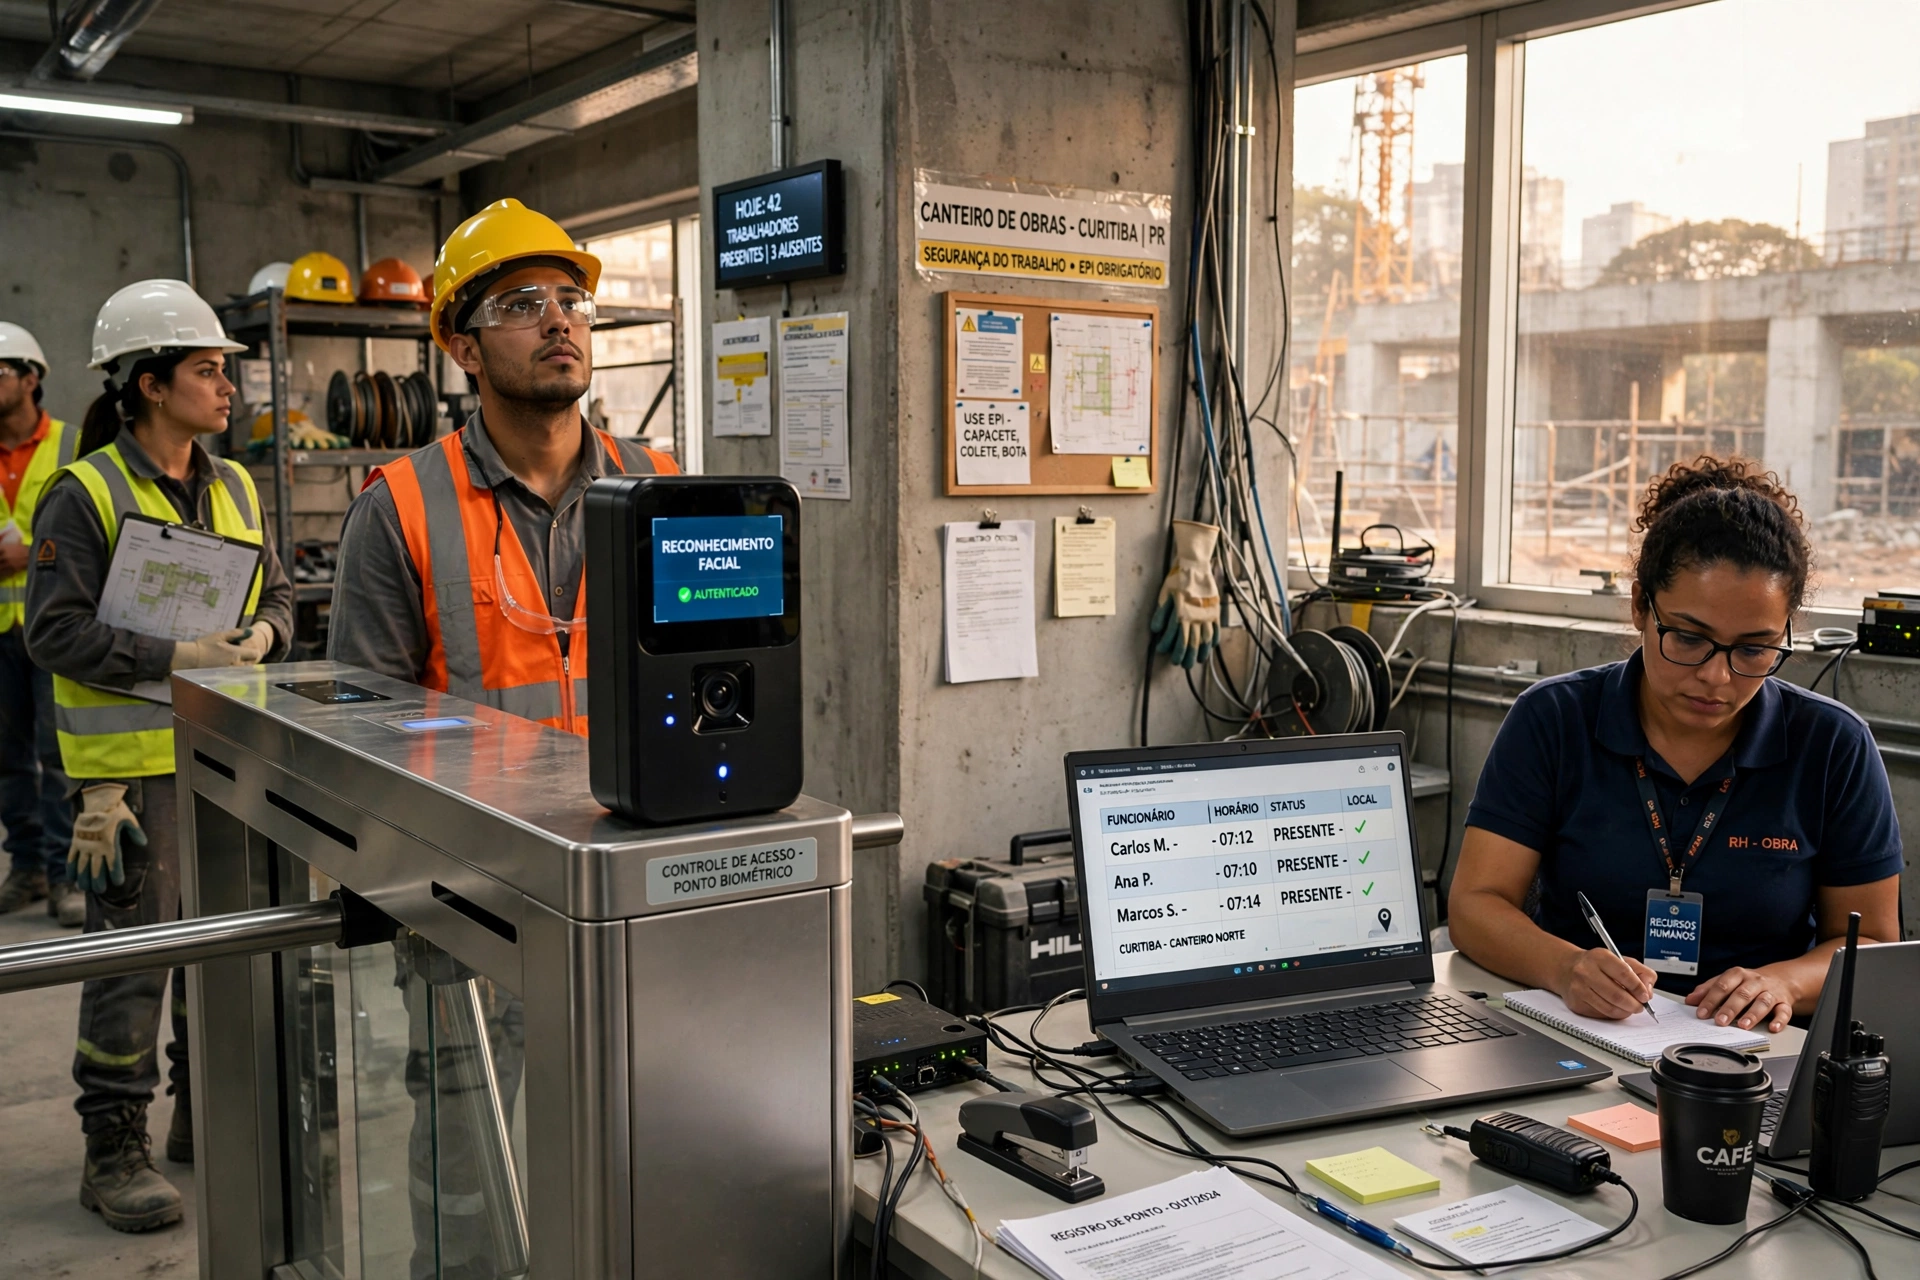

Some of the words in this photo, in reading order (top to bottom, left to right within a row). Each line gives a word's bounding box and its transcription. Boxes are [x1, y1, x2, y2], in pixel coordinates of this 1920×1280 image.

[735, 196, 766, 220] HOJE:
[767, 193, 782, 212] 42
[726, 215, 799, 244] TRABALHADORES
[920, 201, 994, 228] CANTEIRO
[998, 209, 1016, 230] DE
[1020, 211, 1067, 235] OBRAS
[1078, 218, 1138, 243] CURITIBA
[1149, 226, 1166, 246] PR
[720, 246, 764, 268] PRESENTES
[771, 244, 777, 260] 3
[778, 236, 823, 259] AUSENTES
[924, 246, 991, 270] SEGURANÇA
[993, 252, 1009, 267] DO
[1012, 254, 1066, 273] TRABALHO
[1079, 260, 1095, 275] EPI
[1097, 261, 1162, 281] OBRIGATÓRIO
[963, 412, 985, 425] USE
[988, 413, 1005, 425] EPI
[963, 429, 1020, 443] CAPACETE,
[960, 446, 1000, 459] COLETE,
[1002, 446, 1027, 457] BOTA
[661, 537, 774, 554] RECONHECIMENTO
[698, 556, 741, 571] FACIAL
[694, 585, 759, 600] AUTENTICADO
[1107, 807, 1176, 826] FUNCIONÁRIO
[1214, 801, 1259, 817] HORÁRIO
[1270, 799, 1306, 812] STATUS
[1347, 794, 1378, 806] LOCAL
[1110, 839, 1151, 856] Carlos
[1153, 838, 1171, 852] M.
[1219, 830, 1254, 847] 07:12
[1273, 823, 1335, 842] PRESENTE
[1728, 836, 1749, 848] RH
[1761, 837, 1799, 850] OBRA
[662, 857, 728, 878] CONTROLE
[731, 854, 747, 868] DE
[750, 847, 796, 866] ACESSO
[1114, 873, 1140, 890] Ana
[1143, 872, 1154, 887] P.
[1223, 862, 1258, 879] 07:10
[1277, 854, 1339, 873] PRESENTE
[673, 876, 717, 894] PONTO
[720, 865, 793, 887] BIOMÉTRICO
[1117, 905, 1164, 923] Marcos
[1166, 903, 1179, 917] S.
[1226, 894, 1261, 912] 07:14
[1280, 886, 1343, 905] PRESENTE
[1649, 917, 1697, 931] RECURSOS
[1649, 928, 1696, 941] HUMANOS
[1030, 933, 1082, 959] HIL
[1119, 939, 1162, 955] CURITIBA
[1169, 934, 1214, 949] CANTEIRO
[1215, 929, 1246, 943] NORTE
[1696, 1140, 1753, 1166] CAFÉ
[1050, 1222, 1107, 1242] REGISTRO
[1106, 1217, 1125, 1228] DE
[1124, 1206, 1163, 1223] PONTO
